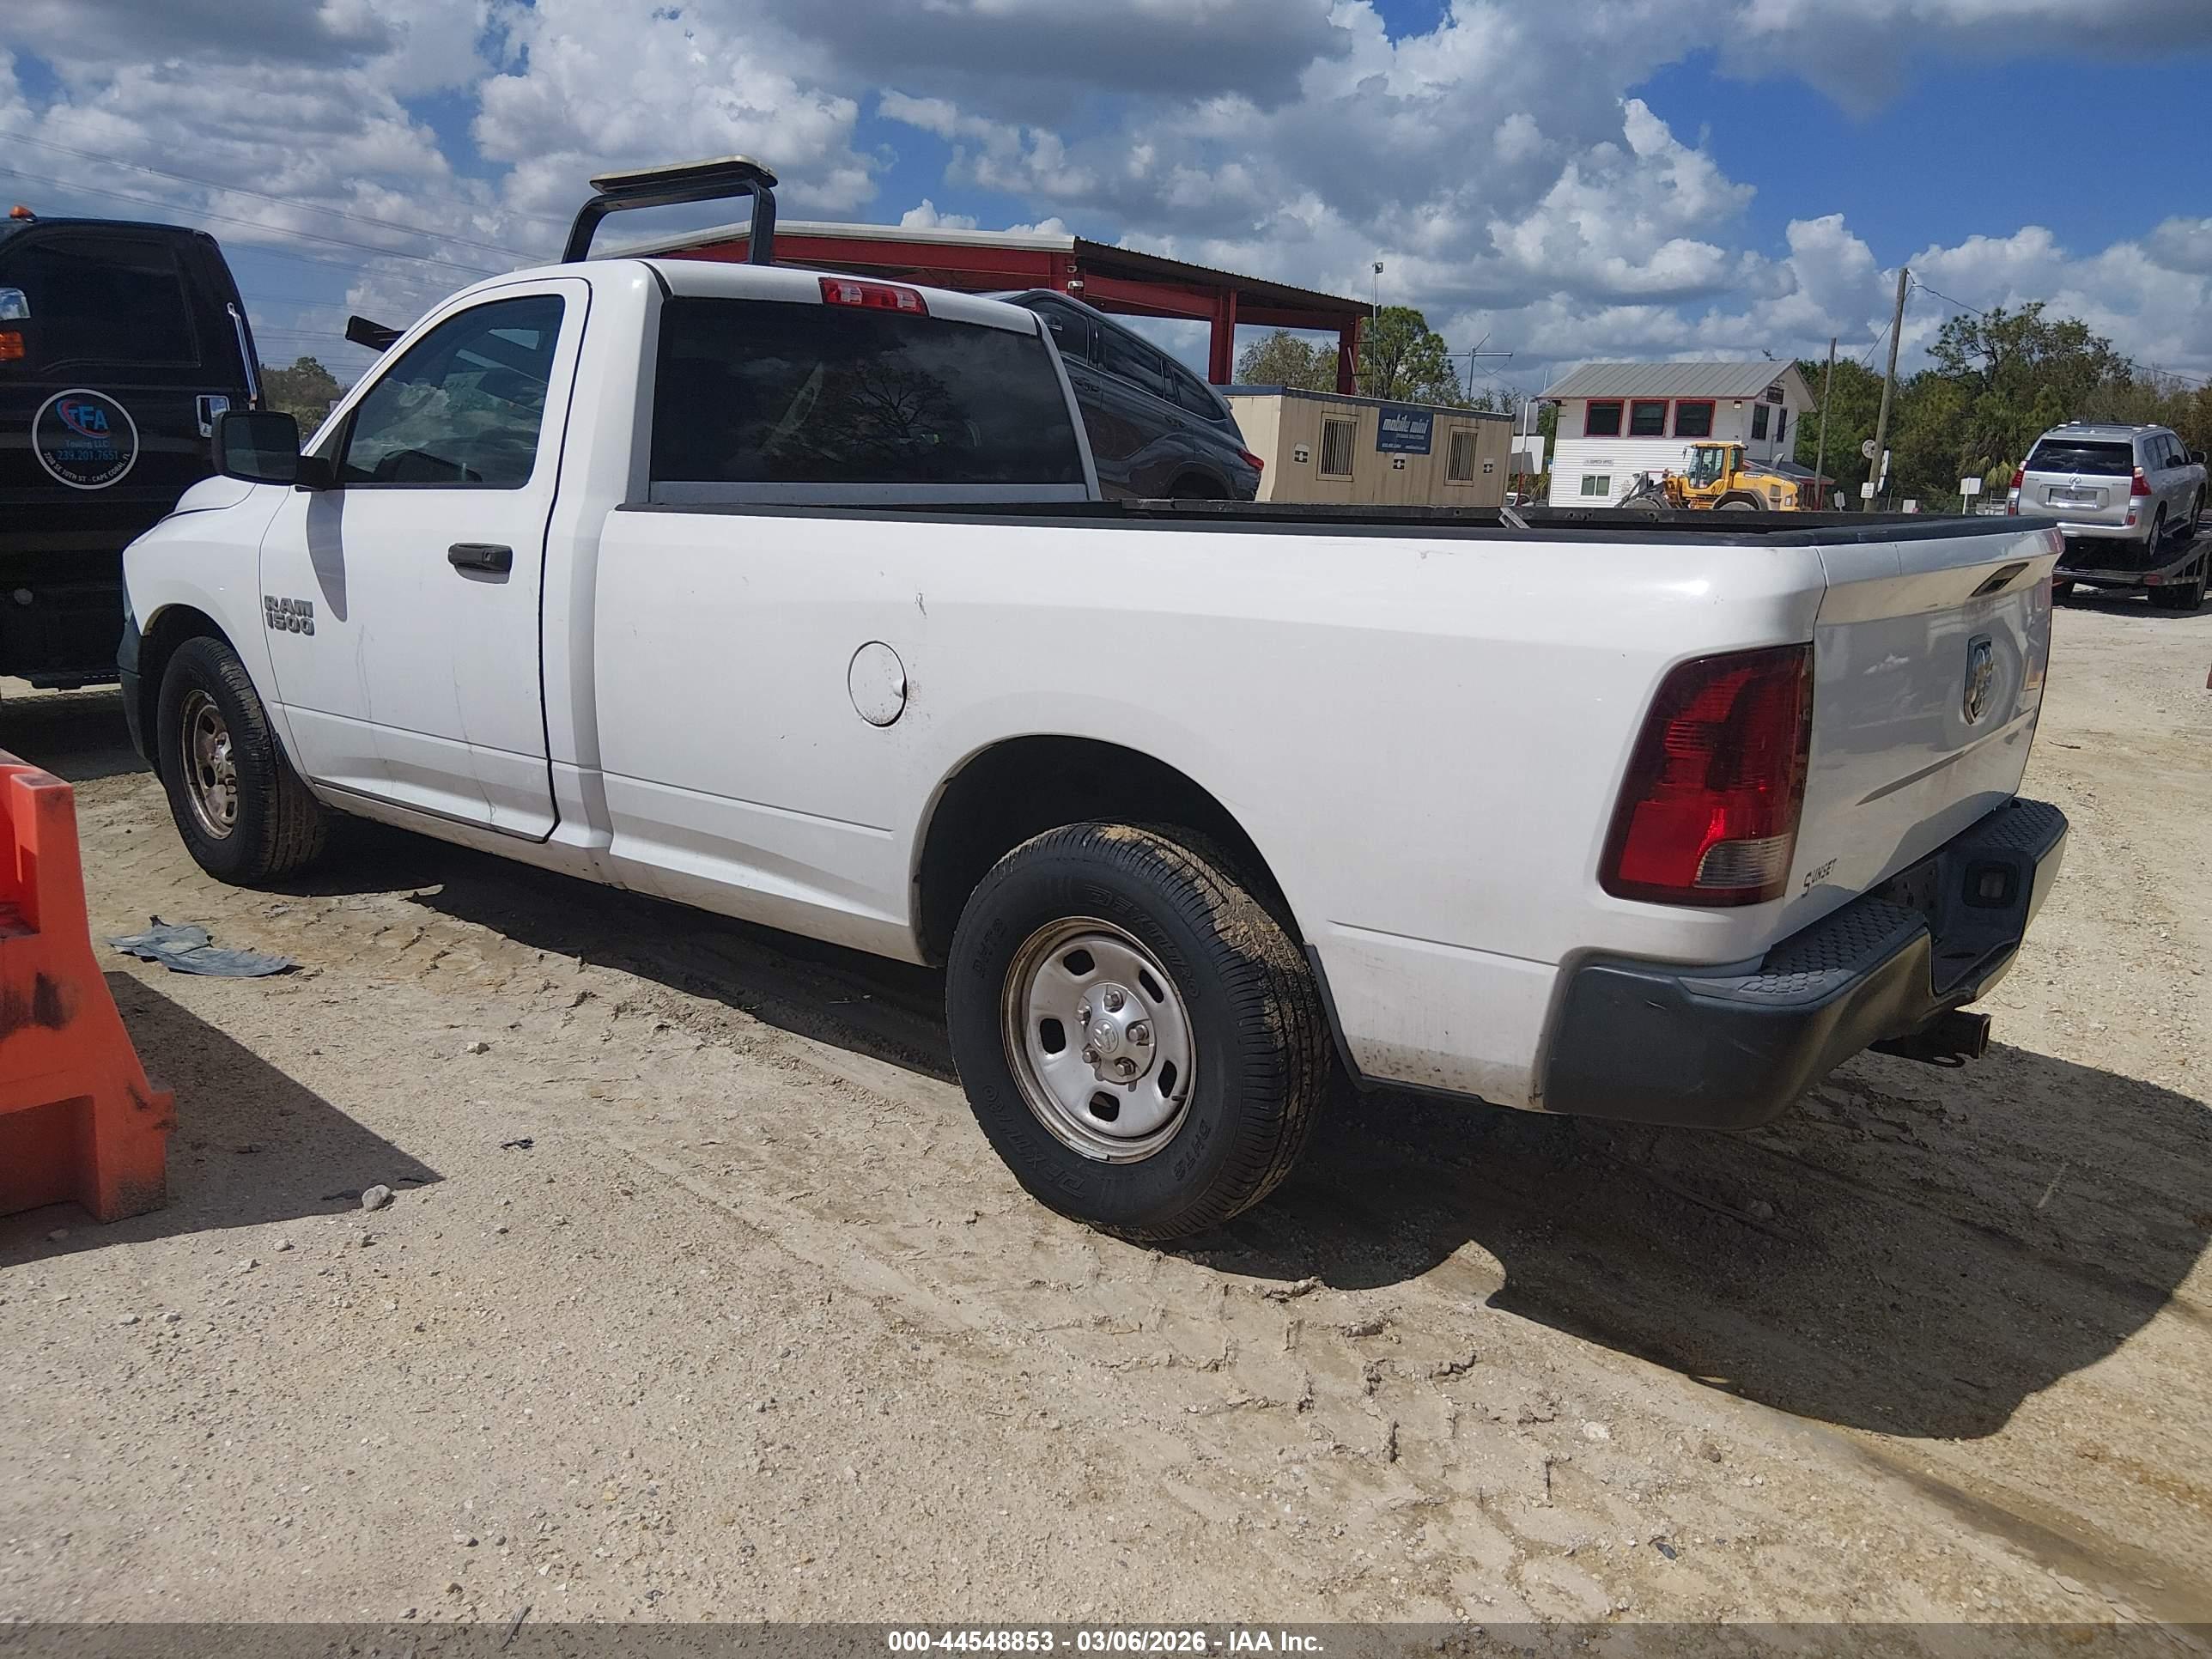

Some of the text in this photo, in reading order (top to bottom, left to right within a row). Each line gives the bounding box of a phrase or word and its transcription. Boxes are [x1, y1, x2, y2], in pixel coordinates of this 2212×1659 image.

[1382, 414, 1429, 434] mobile mini
[92, 474, 109, 483] CAPE
[264, 594, 313, 619] RAM
[265, 611, 315, 637] 1500
